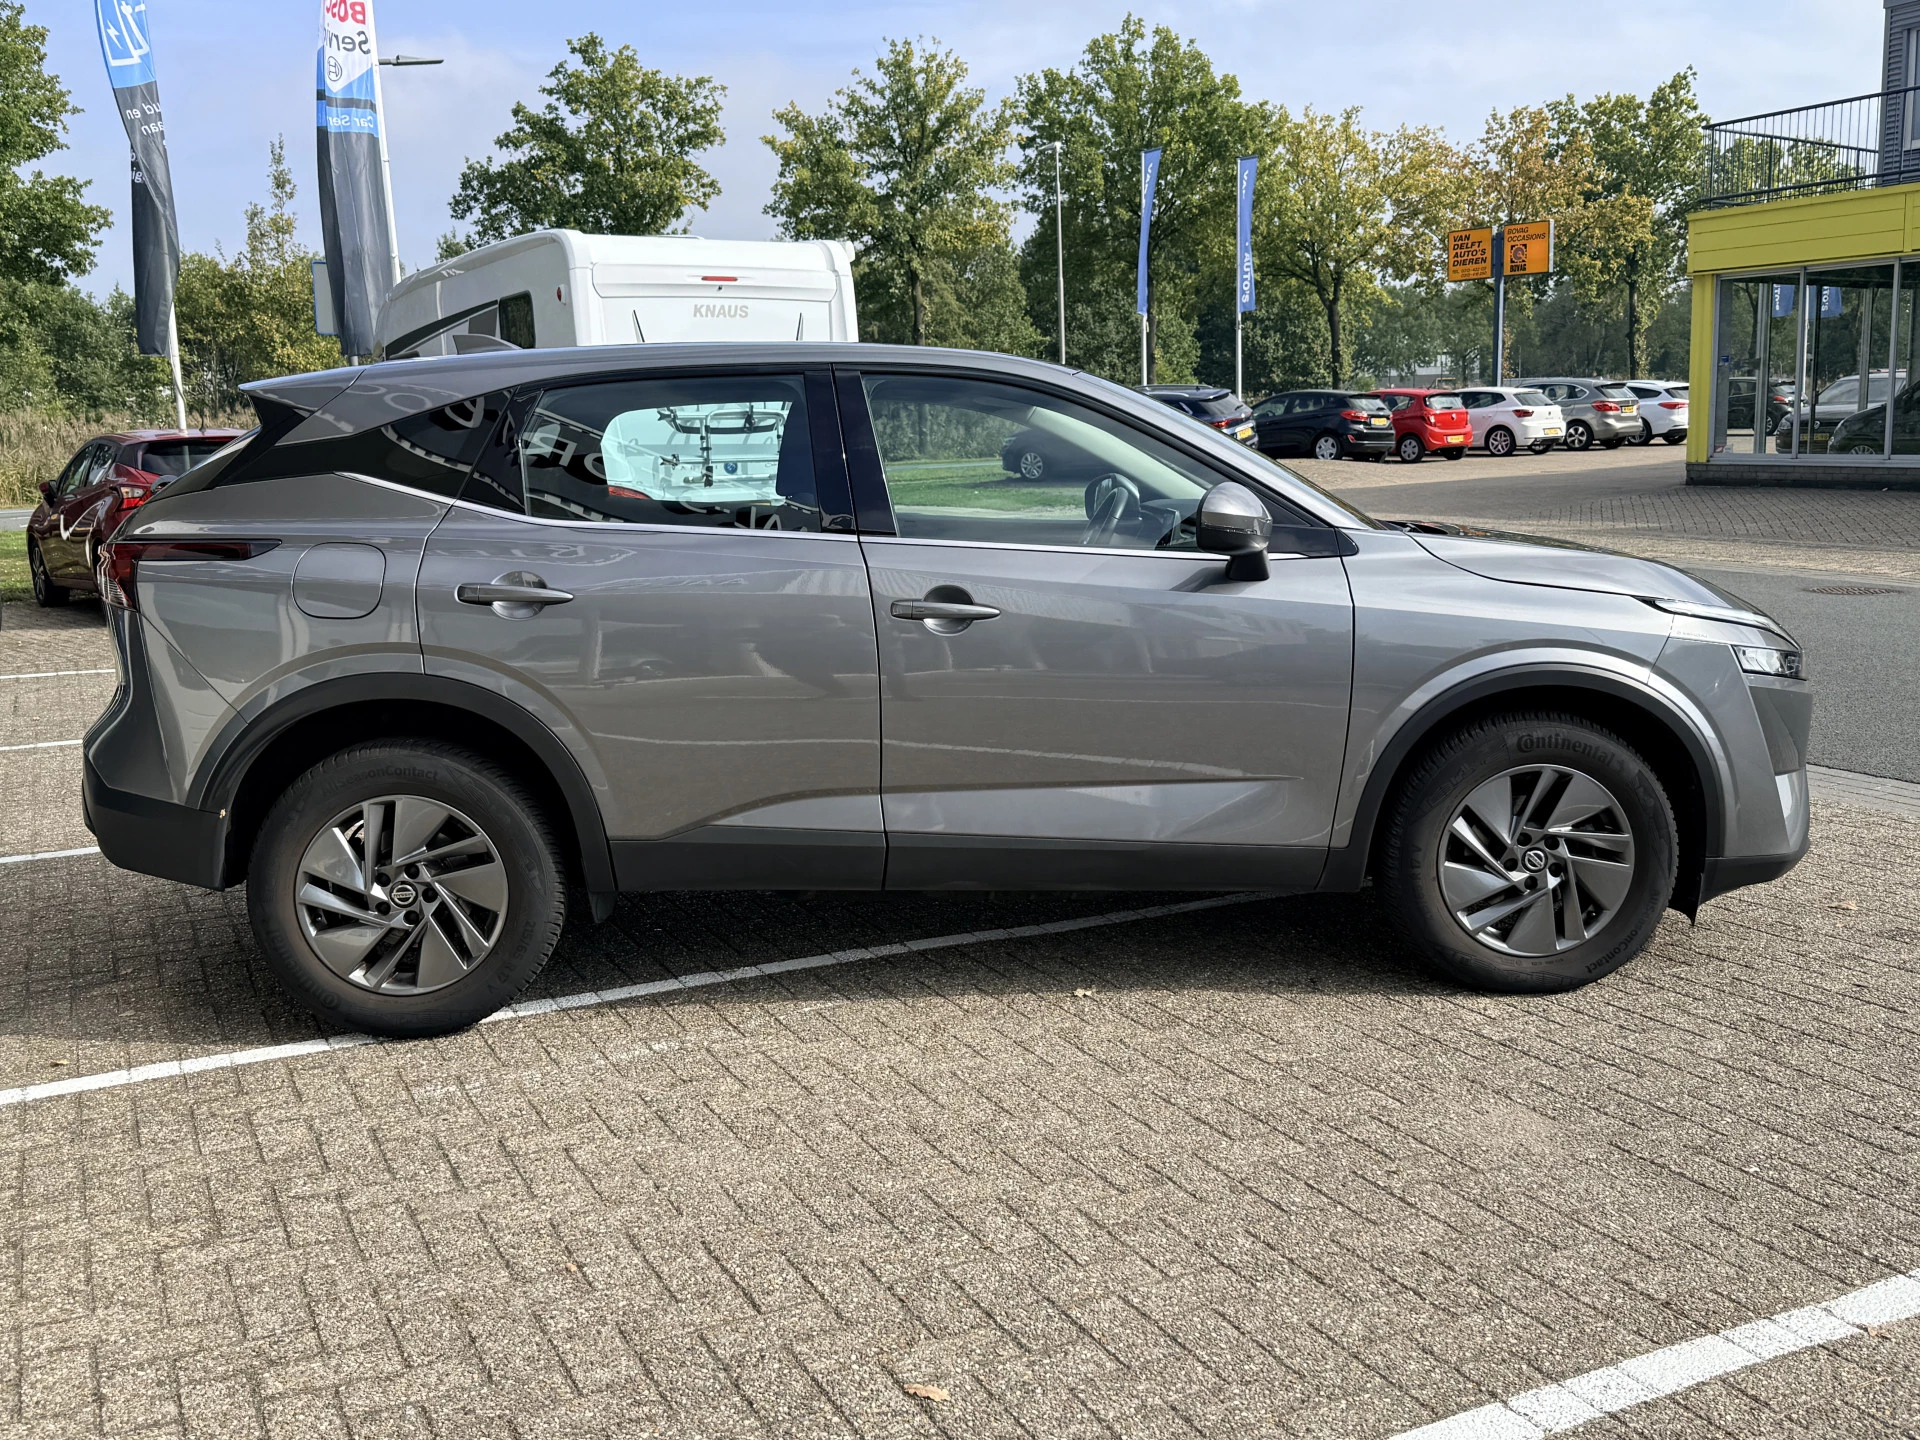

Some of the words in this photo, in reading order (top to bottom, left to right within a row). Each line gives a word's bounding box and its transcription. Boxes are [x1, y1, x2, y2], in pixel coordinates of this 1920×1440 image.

[1507, 226, 1529, 235] BOVAG
[1453, 233, 1471, 243] VAN
[1507, 232, 1546, 243] OCCASIONS
[1453, 240, 1482, 251] DELFT
[1453, 248, 1486, 259] AUTO'S
[1452, 256, 1487, 267] DIEREN
[1241, 252, 1252, 304] AUTO'S
[693, 303, 749, 318] KNAUS
[1516, 732, 1617, 767] Continental
